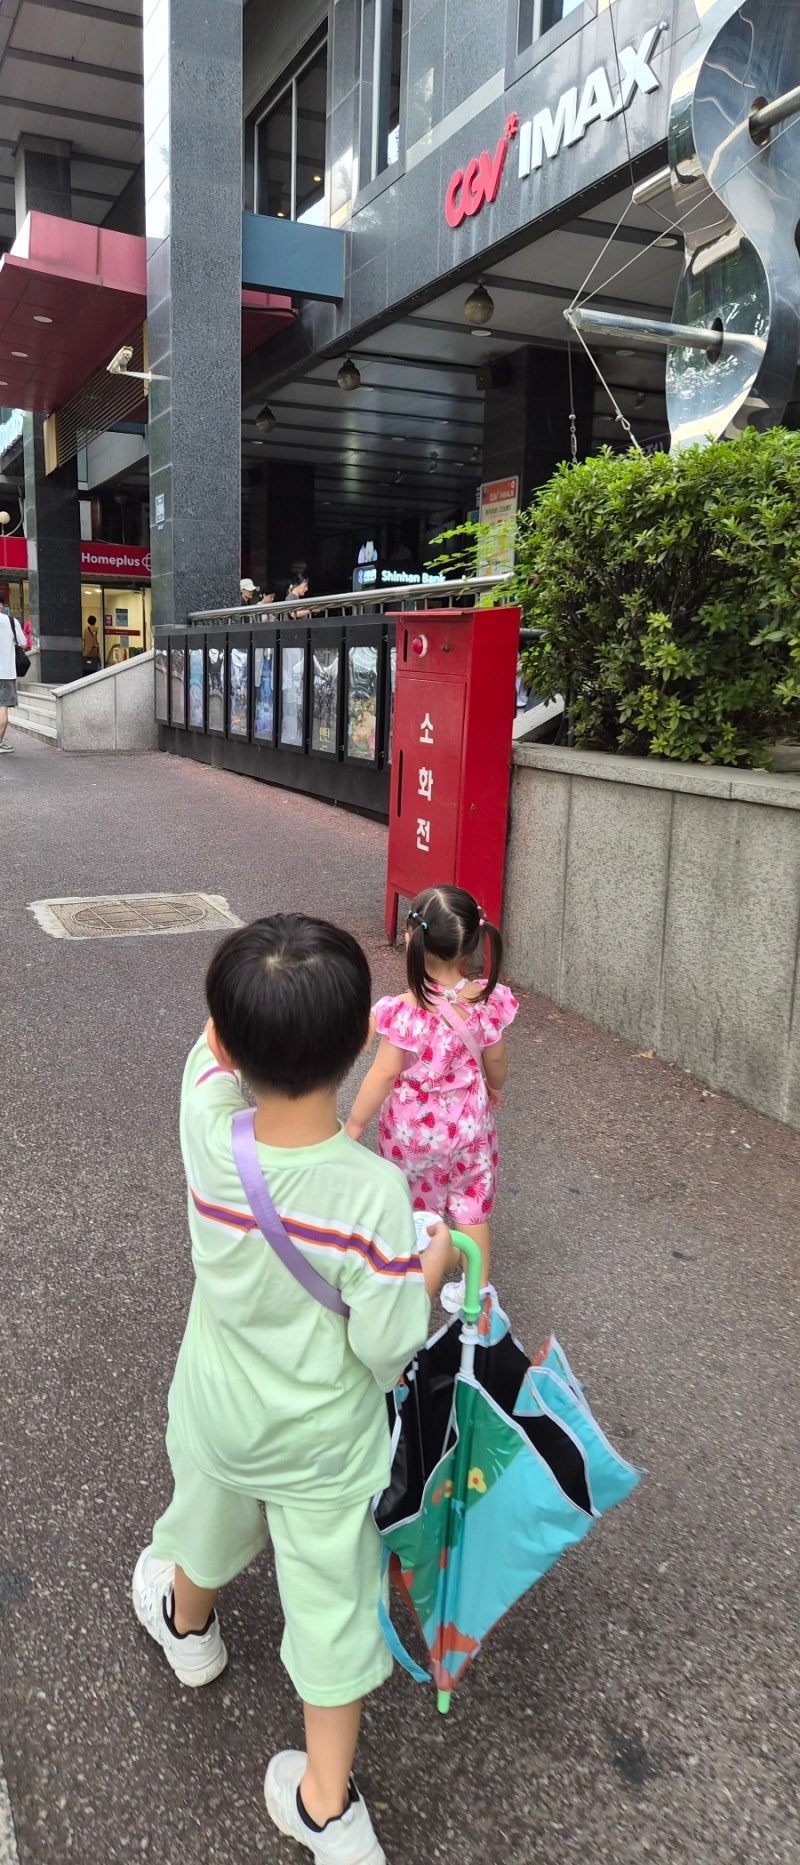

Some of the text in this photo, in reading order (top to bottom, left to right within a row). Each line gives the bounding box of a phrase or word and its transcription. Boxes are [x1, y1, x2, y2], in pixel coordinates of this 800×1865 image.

[444, 25, 661, 228] CGV IMAX
[81, 552, 140, 567] Homeplus
[381, 569, 421, 583] Shinhan
[421, 572, 446, 584] Bank
[416, 713, 434, 852] 소화전
